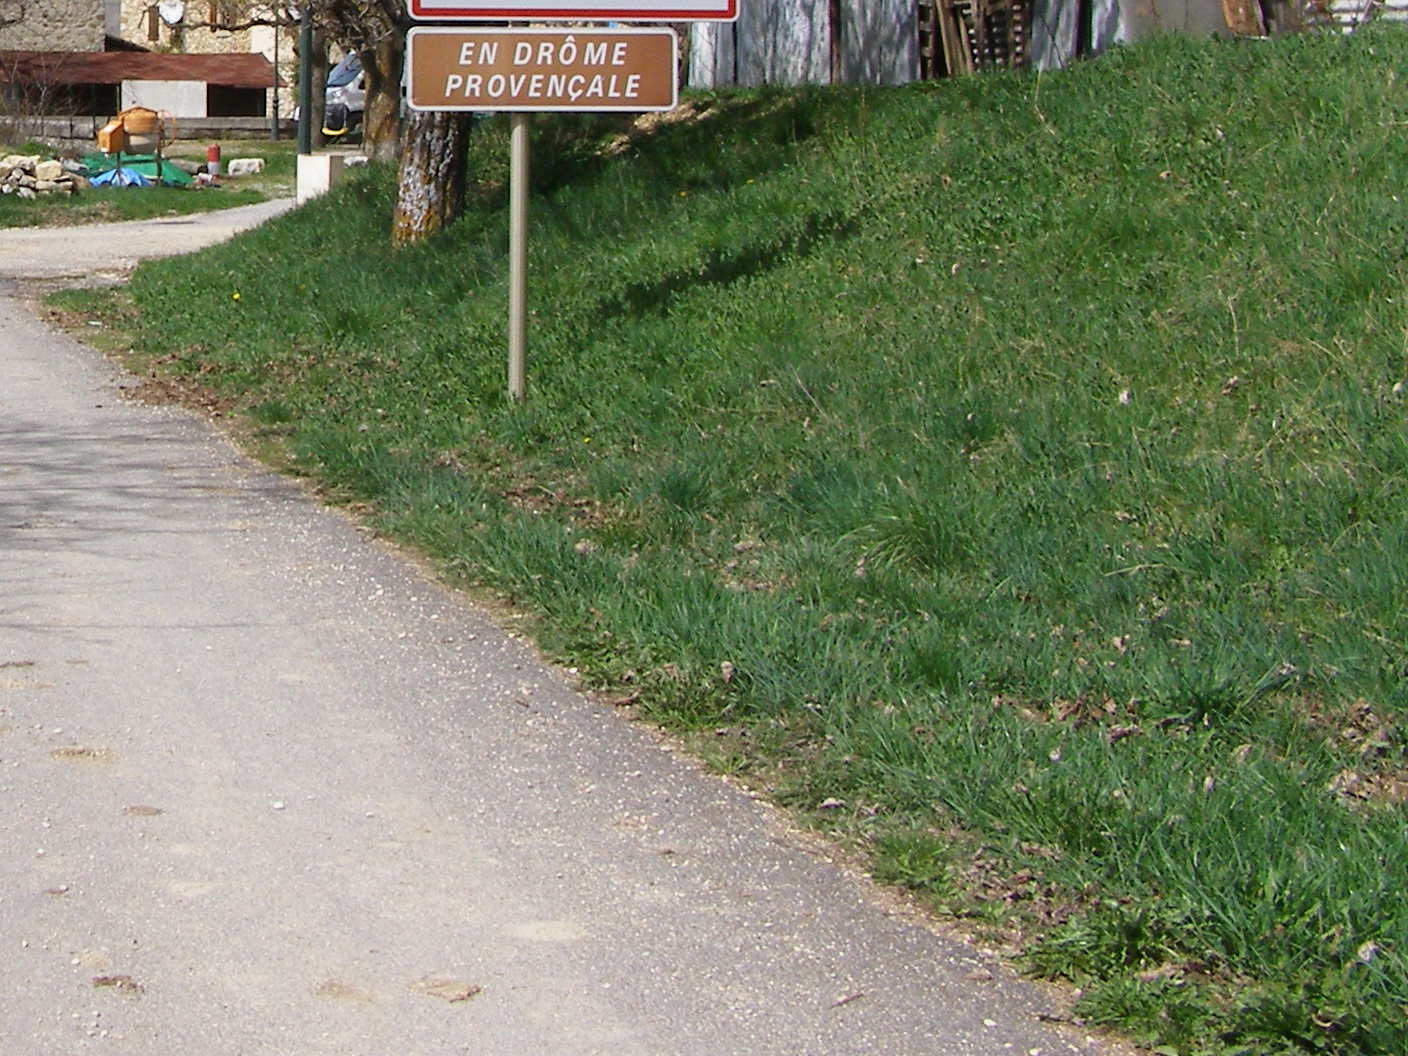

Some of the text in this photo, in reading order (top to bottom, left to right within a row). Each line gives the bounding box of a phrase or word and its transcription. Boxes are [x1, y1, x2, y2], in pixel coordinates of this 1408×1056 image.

[458, 35, 628, 66] EN DRÔME
[444, 74, 641, 101] PROVENÇALE
